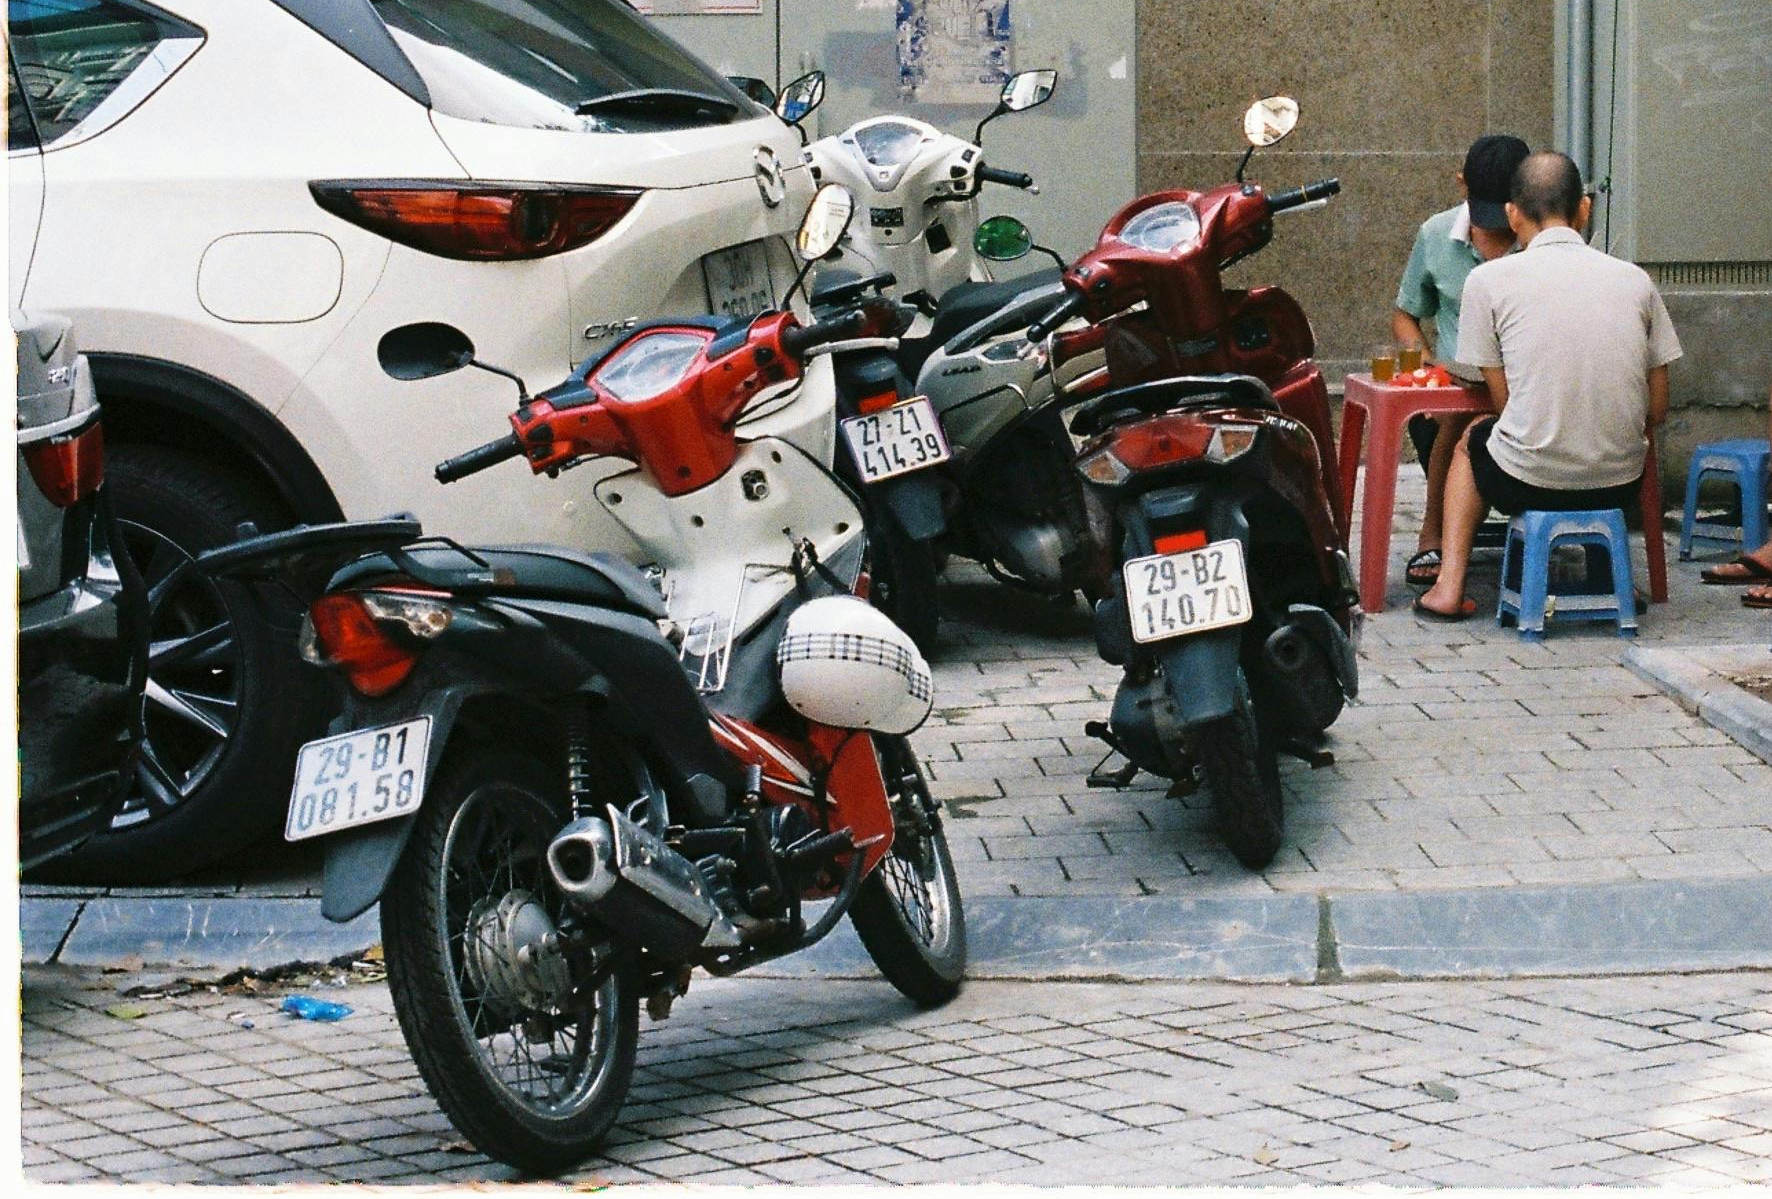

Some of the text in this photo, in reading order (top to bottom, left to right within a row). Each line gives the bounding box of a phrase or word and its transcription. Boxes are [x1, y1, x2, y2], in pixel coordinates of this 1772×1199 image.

[857, 406, 922, 446] 27-Z1
[863, 432, 941, 476] 414.39
[1143, 551, 1227, 595] 29-B2
[1142, 585, 1241, 634] 140.70
[314, 727, 408, 785] 29-B1
[296, 769, 414, 832] 081.58
